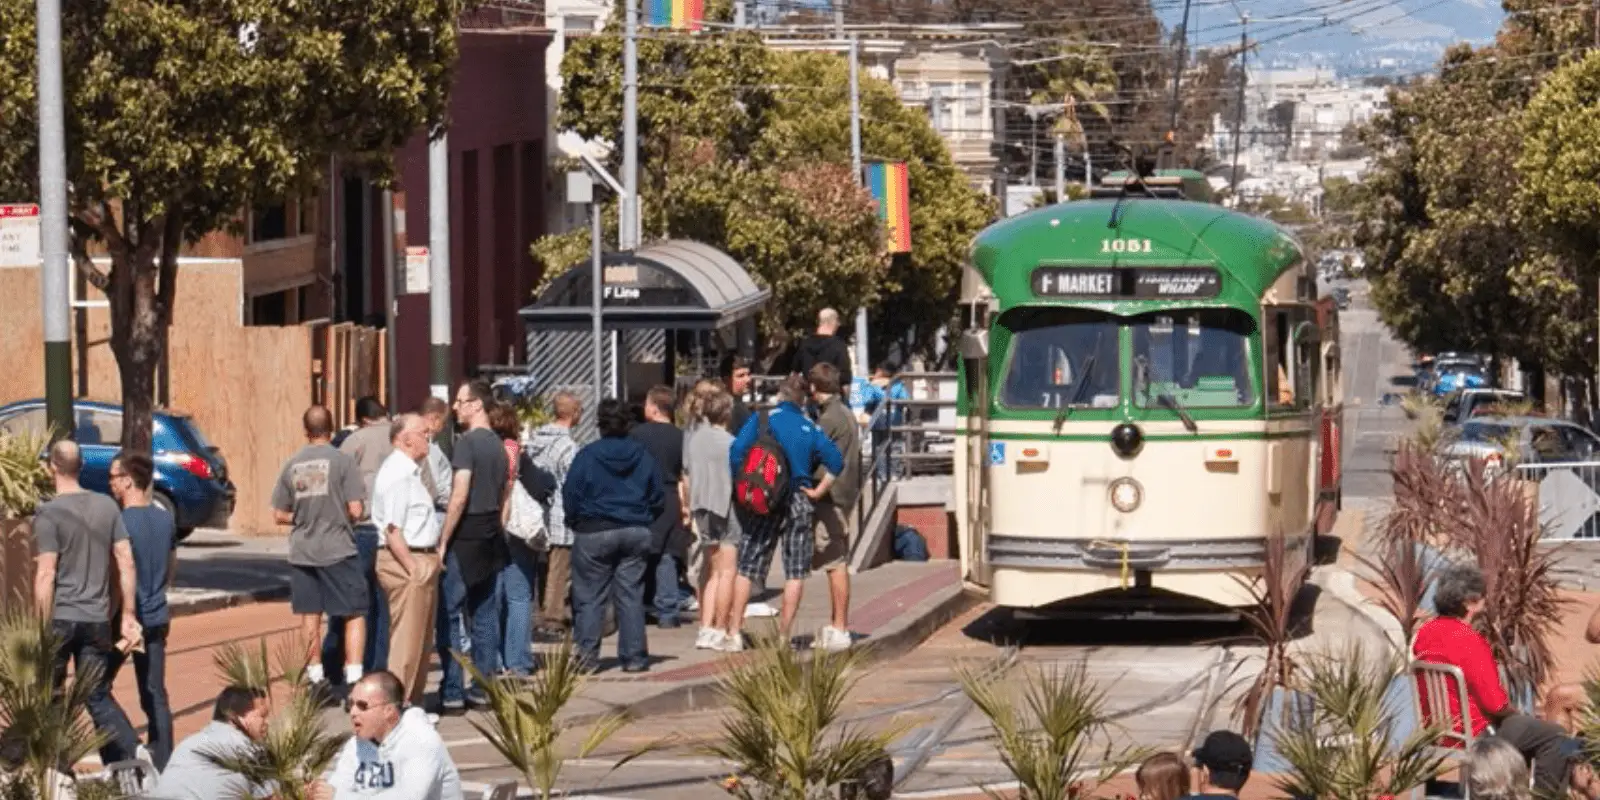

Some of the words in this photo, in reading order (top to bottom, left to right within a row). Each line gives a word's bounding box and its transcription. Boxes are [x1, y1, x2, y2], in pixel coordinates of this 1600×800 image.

[1101, 238, 1152, 252] 1051
[1058, 273, 1114, 294] MARKET
[1158, 282, 1201, 294] WHARF
[603, 287, 612, 299] F
[614, 287, 640, 299] Line
